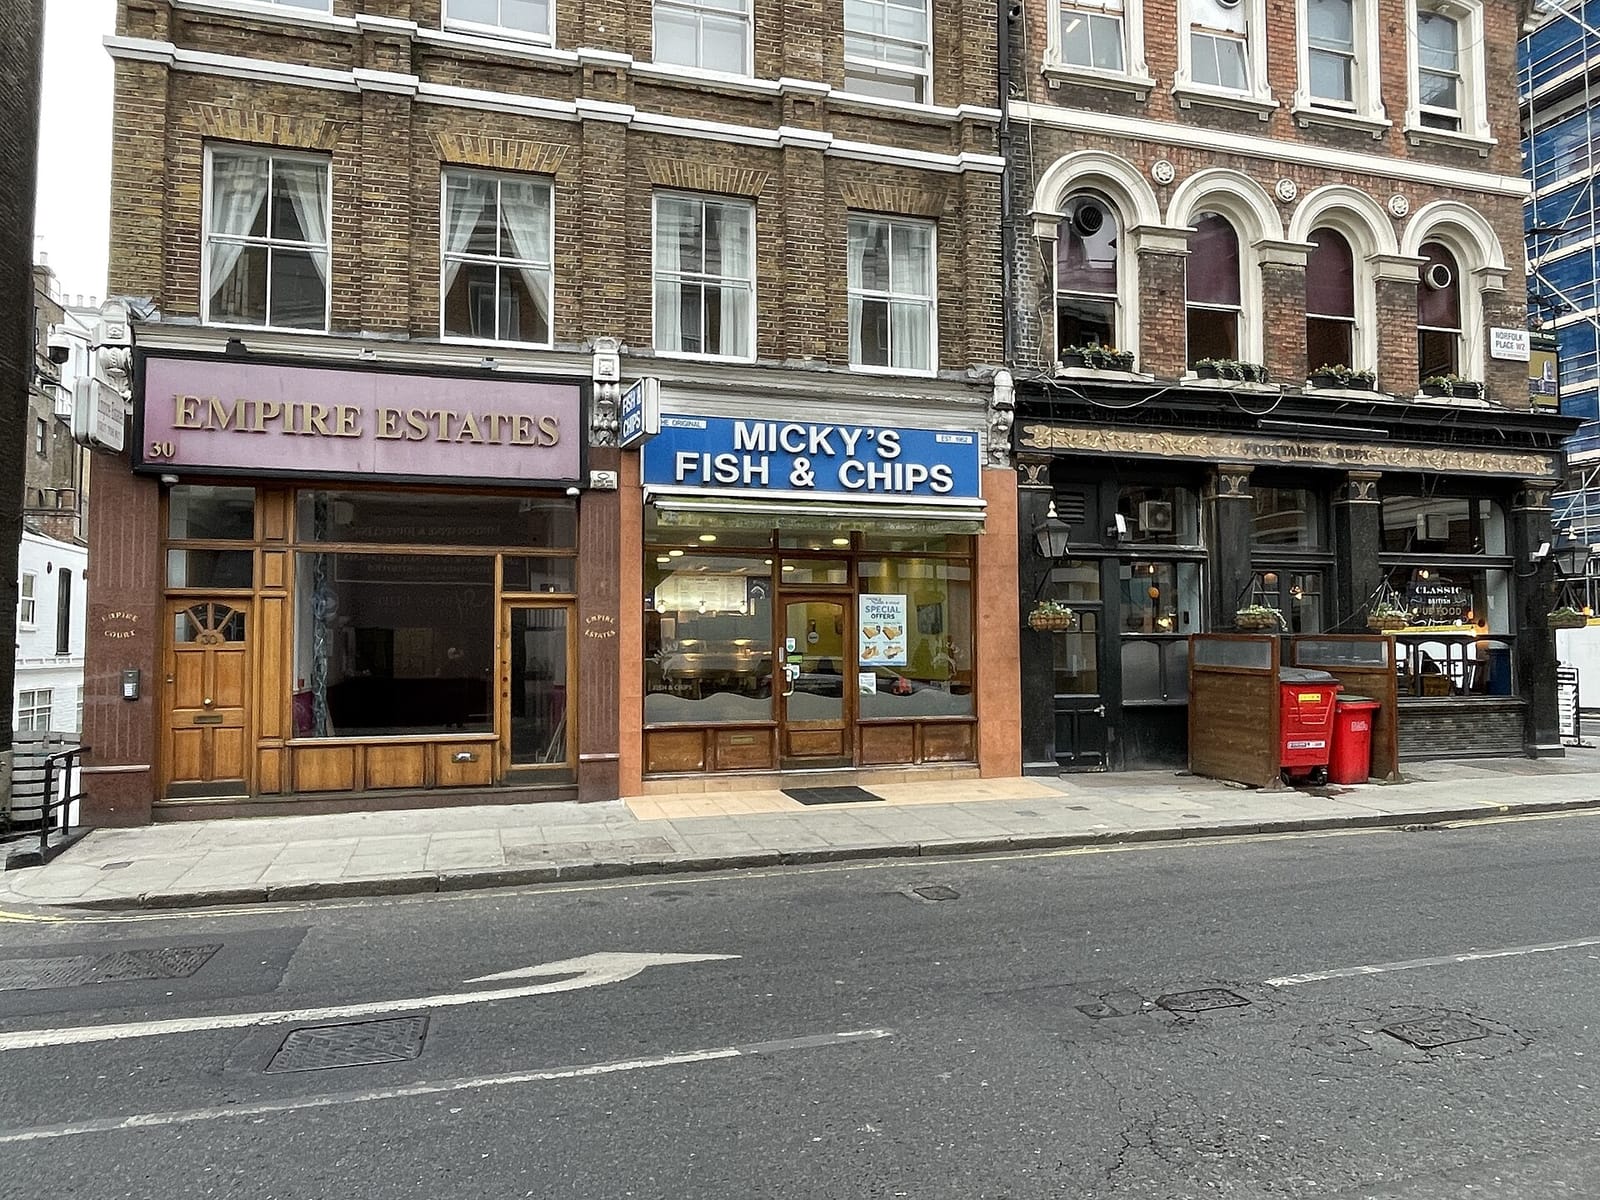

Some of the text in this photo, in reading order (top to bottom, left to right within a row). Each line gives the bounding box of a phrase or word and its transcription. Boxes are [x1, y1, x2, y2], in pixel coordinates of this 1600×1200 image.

[1495, 331, 1523, 342] NORFOLK
[1495, 340, 1526, 352] PLACE W2
[622, 389, 636, 417] FISH
[171, 392, 364, 438] EMPIRE
[375, 406, 560, 447] ESTATES
[622, 410, 641, 438] CHIPS
[671, 419, 701, 429] ORIGINAL
[734, 420, 902, 459] MICKY’S
[149, 440, 176, 458] 30
[674, 451, 954, 493] FISH & CHIPS
[1415, 586, 1462, 594] CLASSIC
[864, 605, 901, 614] SPECIAL
[1436, 606, 1462, 616] FOOD
[585, 614, 615, 624] EMPIRE
[104, 629, 136, 639] COURT
[584, 629, 616, 639] ESTATES
